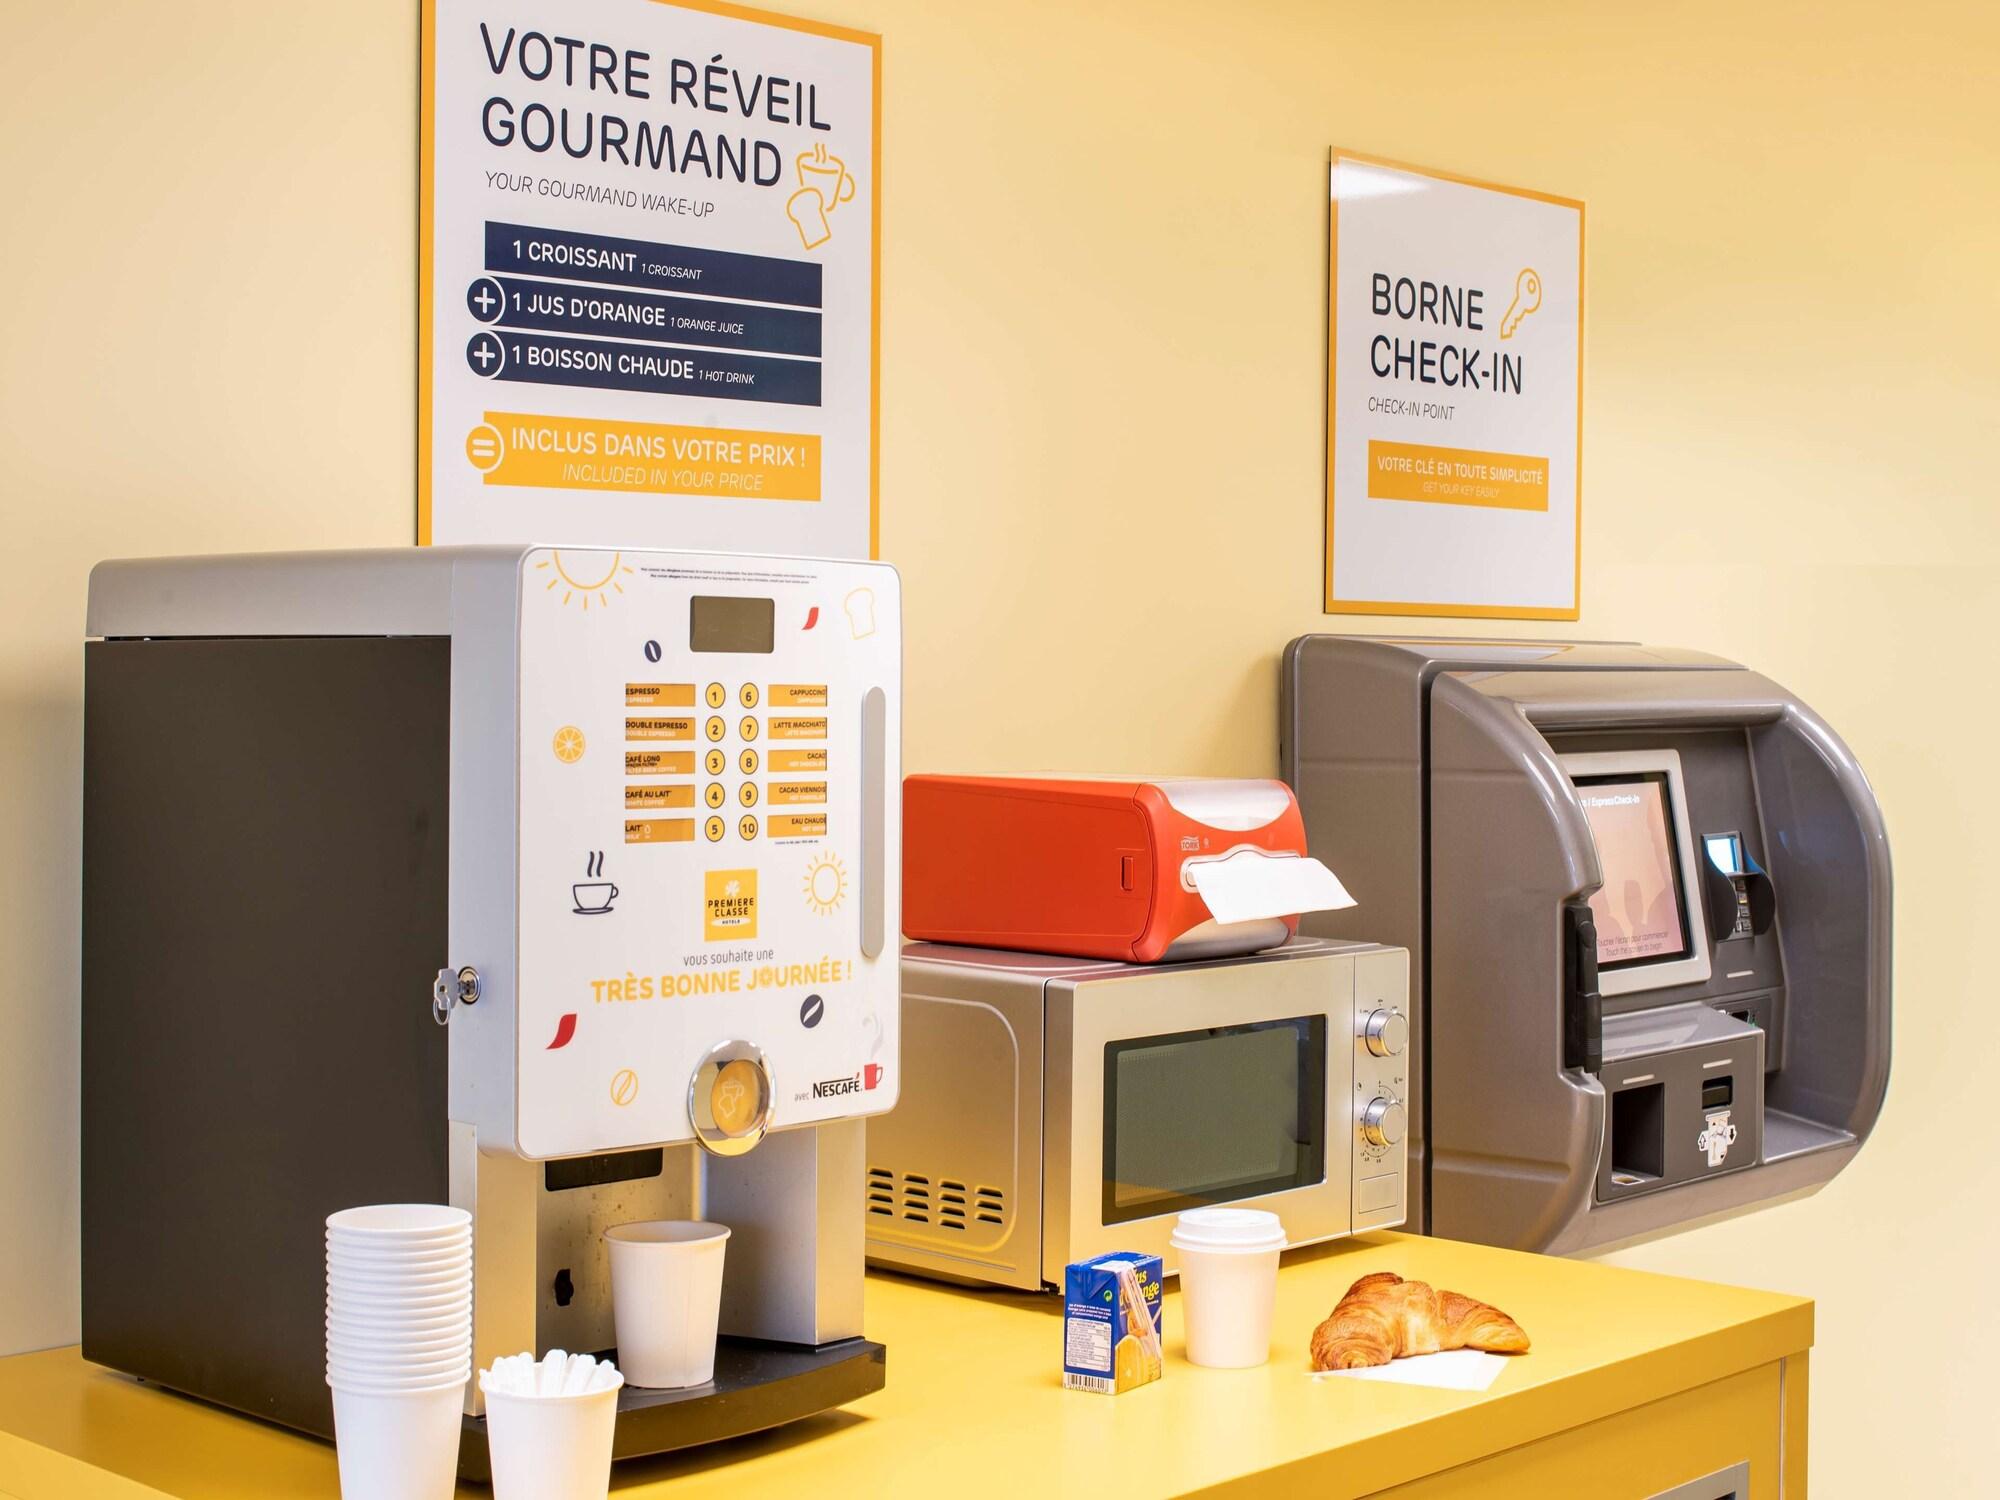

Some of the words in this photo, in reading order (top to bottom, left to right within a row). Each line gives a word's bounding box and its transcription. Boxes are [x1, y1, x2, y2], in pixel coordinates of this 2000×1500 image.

[480, 22, 650, 100] VOTRE
[670, 54, 832, 131] RÉVEIL
[482, 96, 782, 187] GOURMAND
[485, 171, 533, 194] YOUR
[538, 178, 637, 209] GOURMAND
[642, 193, 715, 219] WAKE-UP
[513, 240, 522, 259] 1
[528, 241, 637, 273] CROISSANT
[641, 263, 646, 273] 1
[648, 263, 702, 280] CROISSANT
[1372, 273, 1484, 331] BORNE
[512, 292, 521, 311] 1
[527, 294, 564, 316] JUS
[571, 299, 666, 327] D'ORANGE
[670, 317, 675, 327] 1
[677, 317, 716, 332] ORANGE
[717, 322, 744, 335] JUICE
[512, 345, 521, 364] 1
[527, 346, 612, 372] BOISSON
[618, 356, 693, 380] CHAUDE
[699, 369, 703, 381] 1
[705, 370, 725, 382] HOT
[725, 372, 755, 385] DRINK
[1371, 334, 1522, 395] CHECK-IN
[1368, 396, 1420, 418] CHECK-IN
[1423, 403, 1455, 421] POINT
[512, 427, 597, 454] INCLUS
[604, 433, 666, 460] DANS
[672, 438, 742, 464] VOTRE
[749, 443, 796, 467] PRIX
[1377, 456, 1412, 472] VOTRE
[1415, 458, 1435, 475] CLÉ
[1437, 462, 1451, 476] EN
[1455, 463, 1487, 480] TOUTE
[1489, 466, 1543, 485] SIMPLICITÉ
[562, 463, 646, 486] INCLUDED
[650, 468, 668, 487] IN
[672, 469, 714, 489] YOUR
[718, 472, 764, 492] PRICE
[1423, 482, 1437, 493] GET
[712, 692, 717, 702] 1
[746, 692, 752, 702] 6
[625, 721, 652, 729] DOUBLE
[654, 722, 688, 730] ESPRESSO
[712, 725, 719, 735] 2
[746, 724, 752, 735] 7
[625, 754, 642, 763] CAFÉ
[712, 758, 718, 768] 3
[746, 757, 752, 768] 8
[625, 790, 643, 798] CAFÉ
[712, 791, 718, 801] 4
[745, 790, 752, 800] 9
[712, 824, 718, 835] 5
[742, 823, 755, 833] 10
[708, 897, 754, 908] PREMIERE
[715, 907, 748, 917] CLASSE
[683, 953, 708, 966] vous
[710, 949, 754, 965] souhaite
[756, 949, 774, 961] une
[590, 971, 654, 1004] TRÈS
[661, 969, 741, 999] BONNE
[746, 956, 842, 991] JOURNÉE
[794, 1092, 810, 1102] avec
